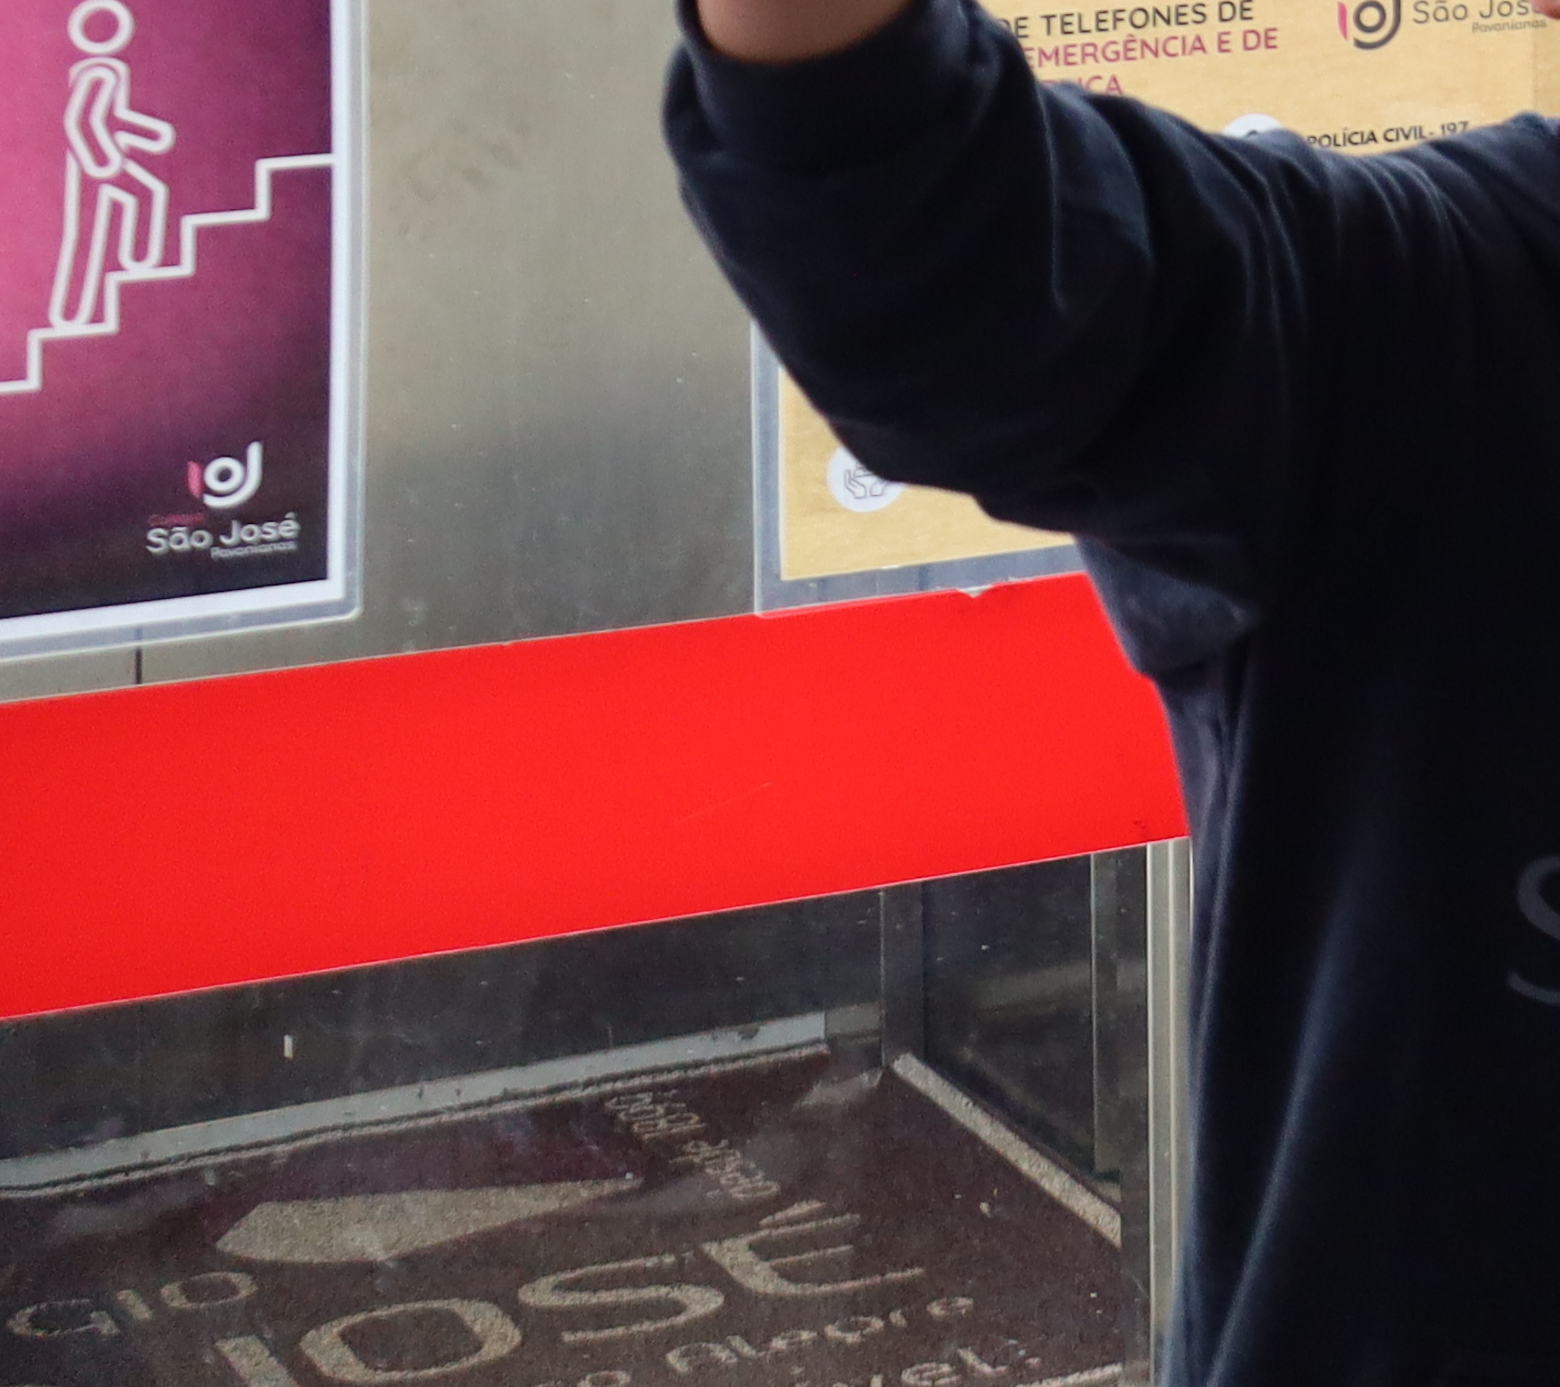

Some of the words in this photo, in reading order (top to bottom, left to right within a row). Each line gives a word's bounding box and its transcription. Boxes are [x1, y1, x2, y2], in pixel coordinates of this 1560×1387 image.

[1040, 2, 1208, 36] TELEFONES
[1412, 0, 1469, 24] São
[1216, 31, 1232, 54] E
[1241, 27, 1280, 52] DE
[1382, 124, 1427, 143] CIVIL
[146, 526, 213, 555] São
[219, 511, 301, 546] José
